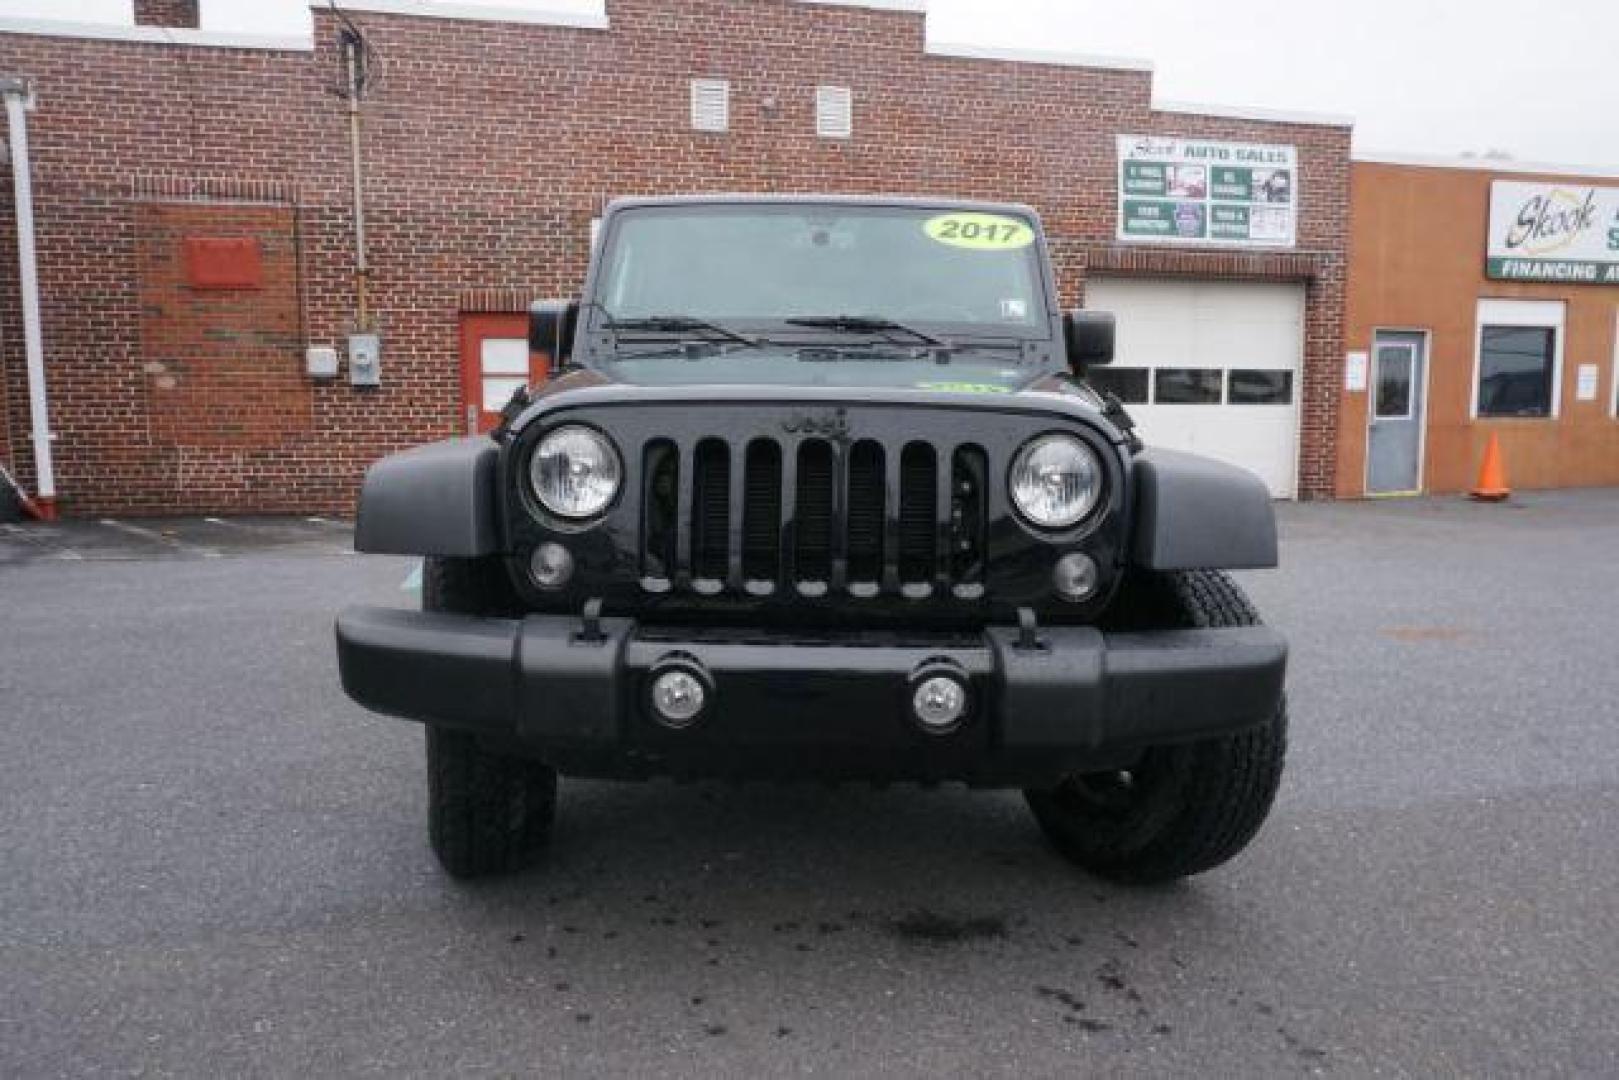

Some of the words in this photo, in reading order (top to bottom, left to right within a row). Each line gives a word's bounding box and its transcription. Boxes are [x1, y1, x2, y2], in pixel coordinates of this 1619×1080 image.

[1184, 145, 1231, 160] AUTO
[1236, 149, 1288, 163] SALES
[938, 219, 1020, 244] 2017
[1502, 261, 1597, 281] FINANCING
